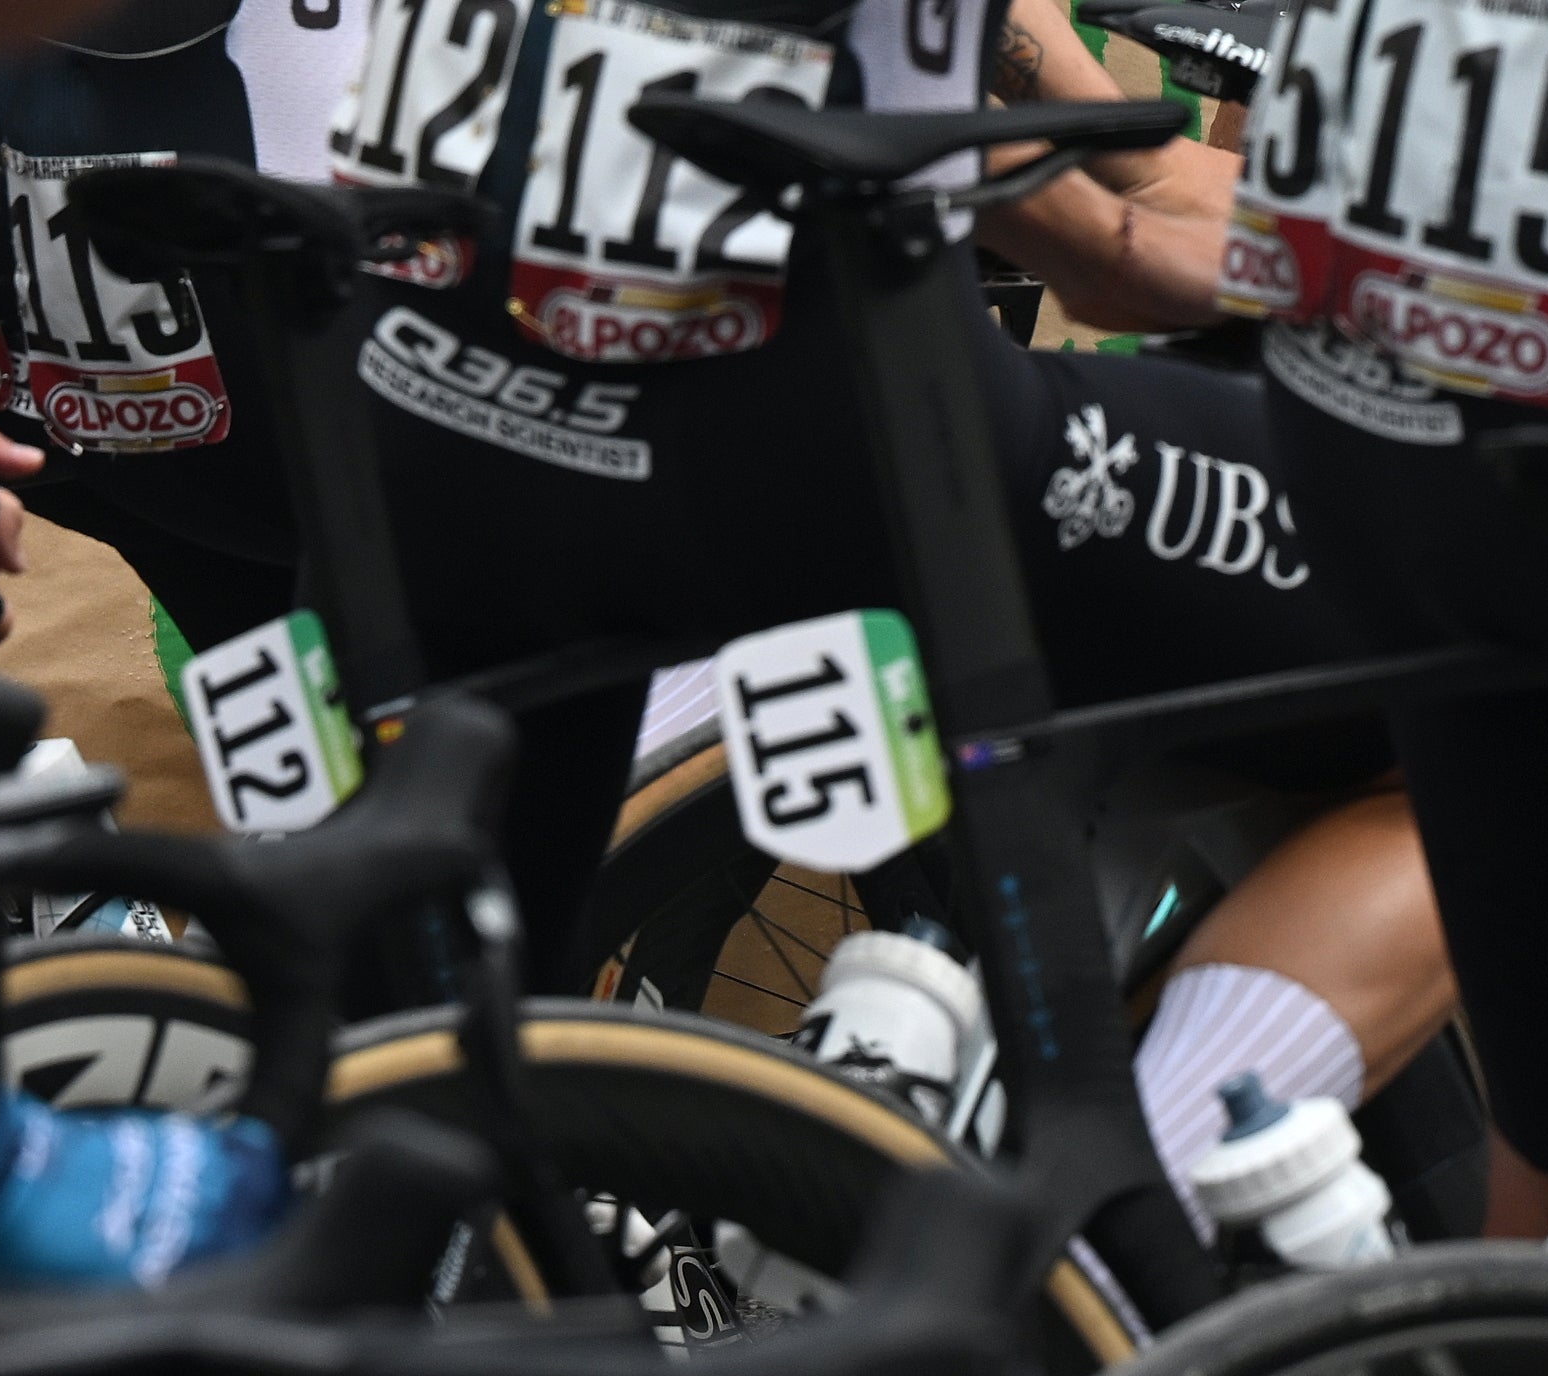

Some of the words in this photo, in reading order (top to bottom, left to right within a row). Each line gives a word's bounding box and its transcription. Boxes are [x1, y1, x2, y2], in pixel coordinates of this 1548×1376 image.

[372, 304, 643, 435] Q36.5
[199, 649, 312, 822] 112
[733, 651, 876, 829] 115
